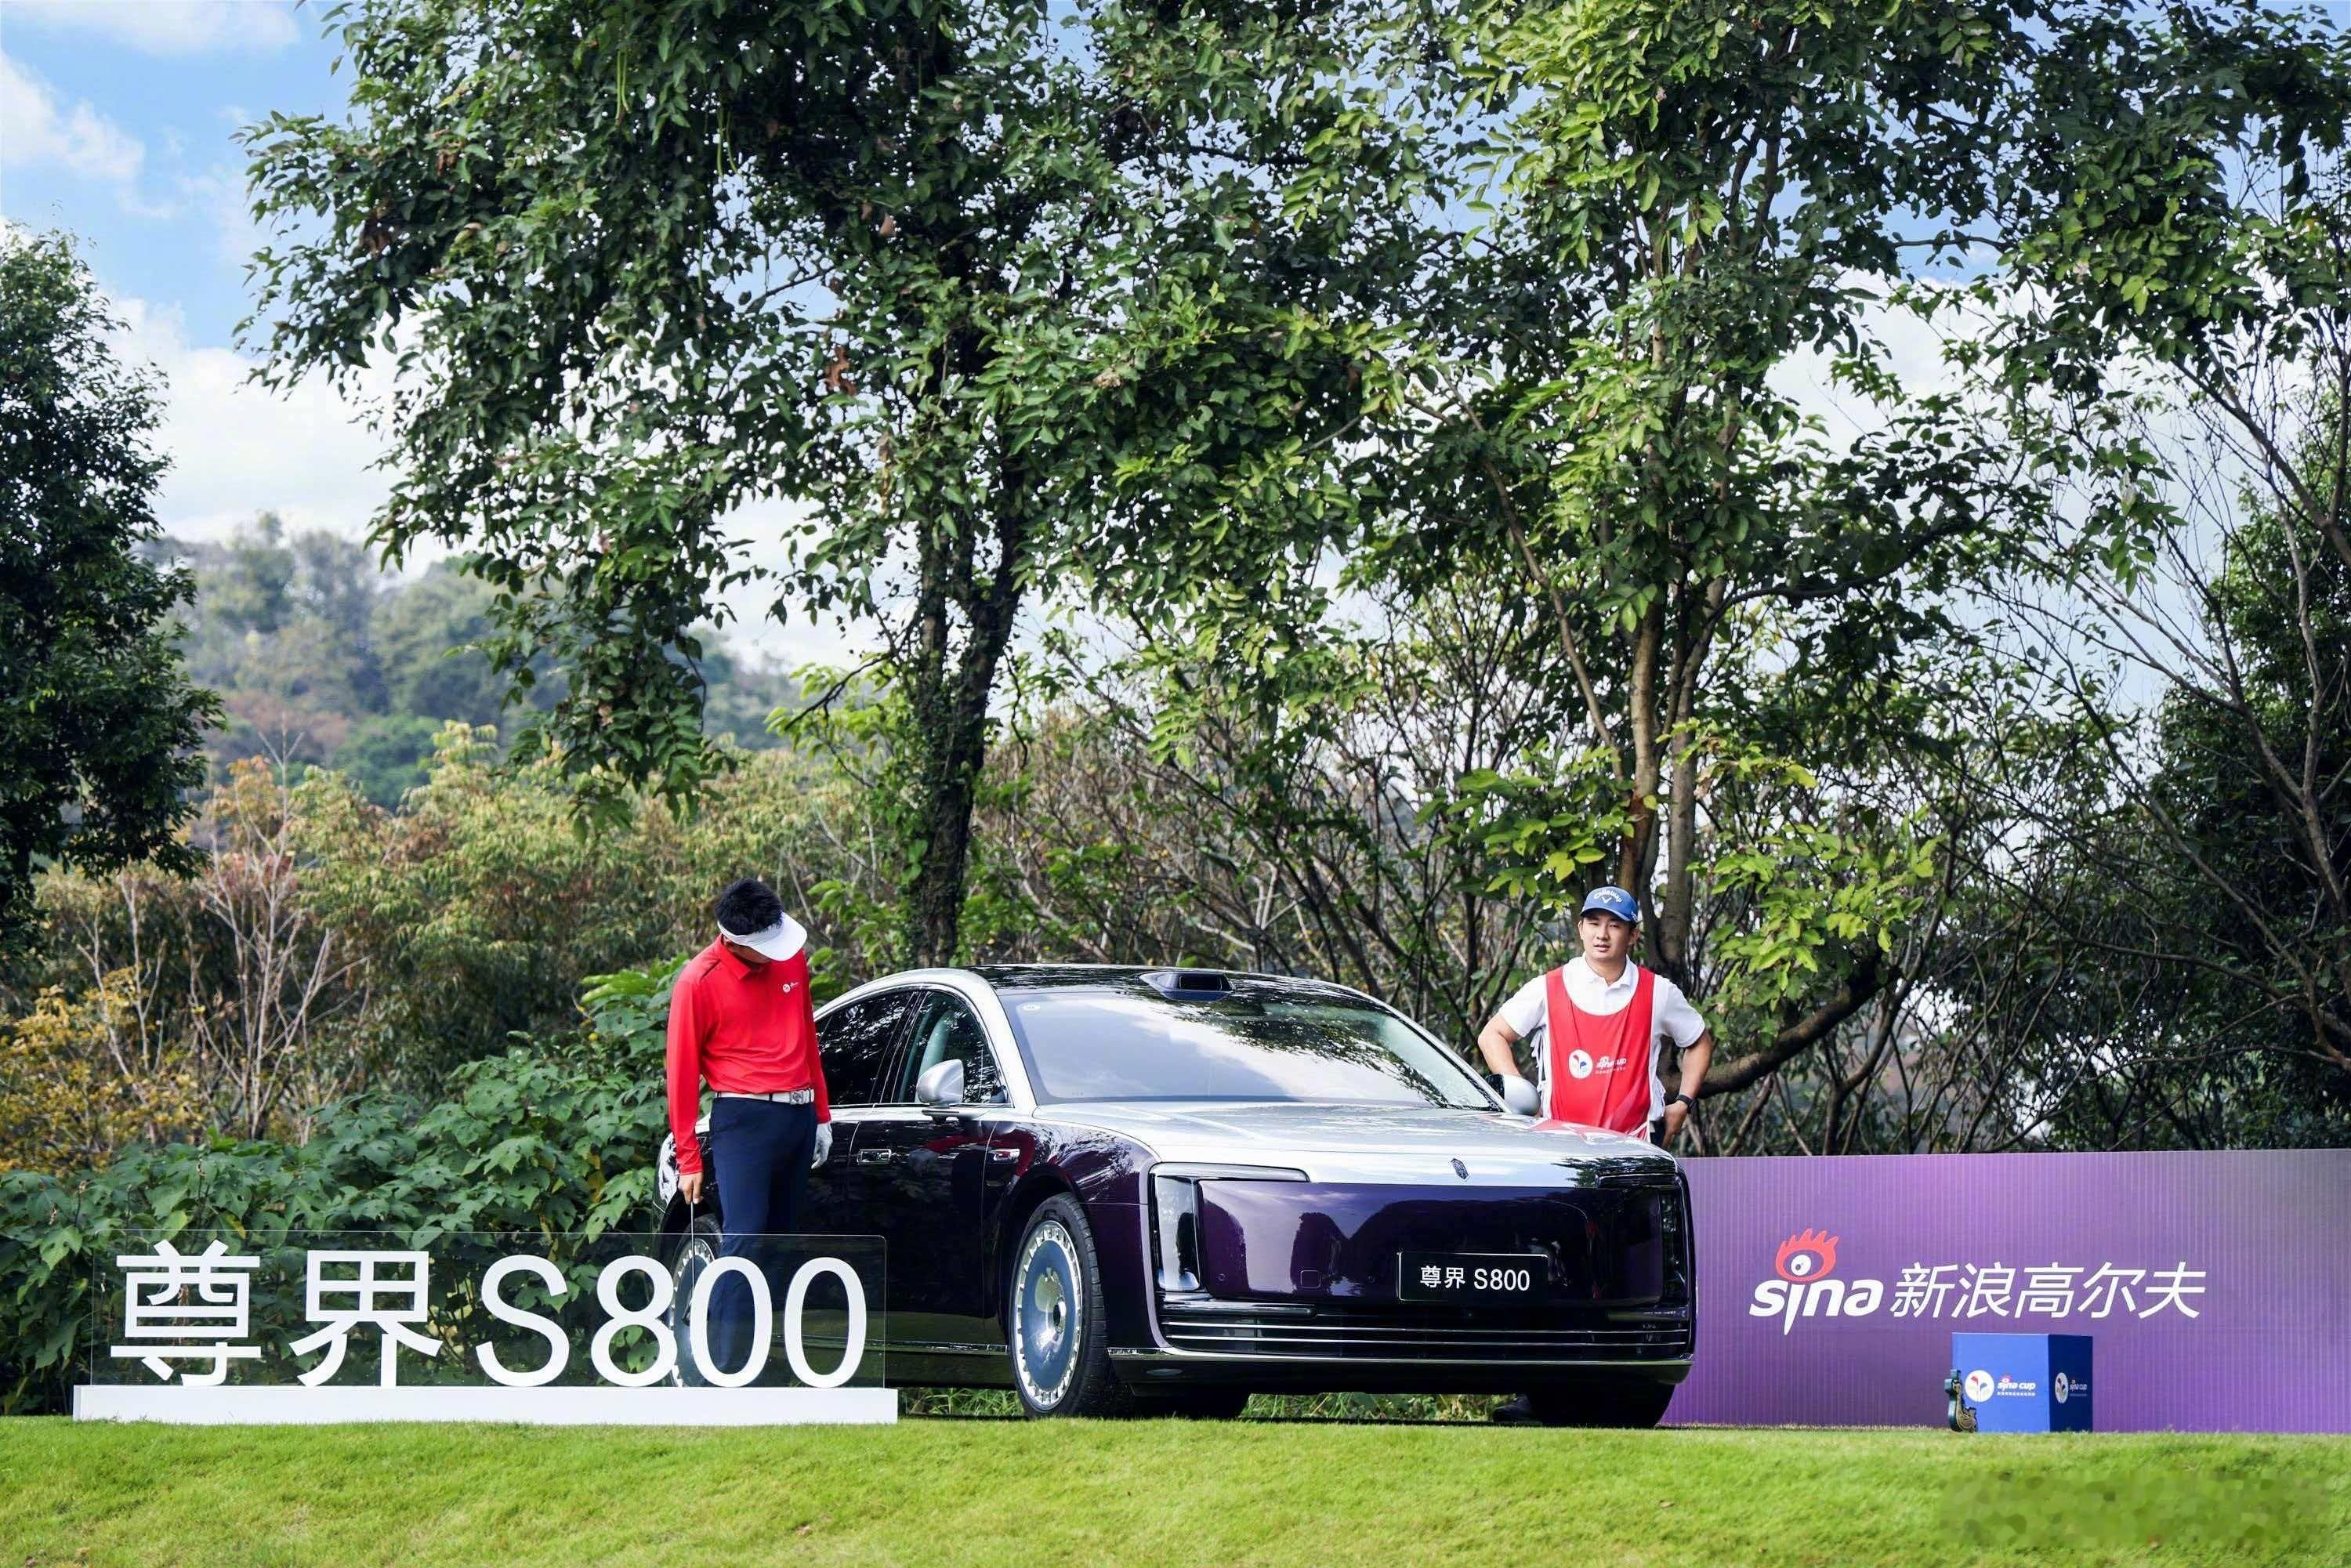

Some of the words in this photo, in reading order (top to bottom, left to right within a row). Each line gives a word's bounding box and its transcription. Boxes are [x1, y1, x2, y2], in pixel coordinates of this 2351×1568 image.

[110, 1240, 441, 1388] 尊界
[475, 1254, 868, 1389] S800
[1420, 1266, 1465, 1289] 尊界
[1473, 1268, 1531, 1291] S800
[1749, 1279, 1884, 1335] sina
[1889, 1261, 2207, 1319] 新浪高尔夫
